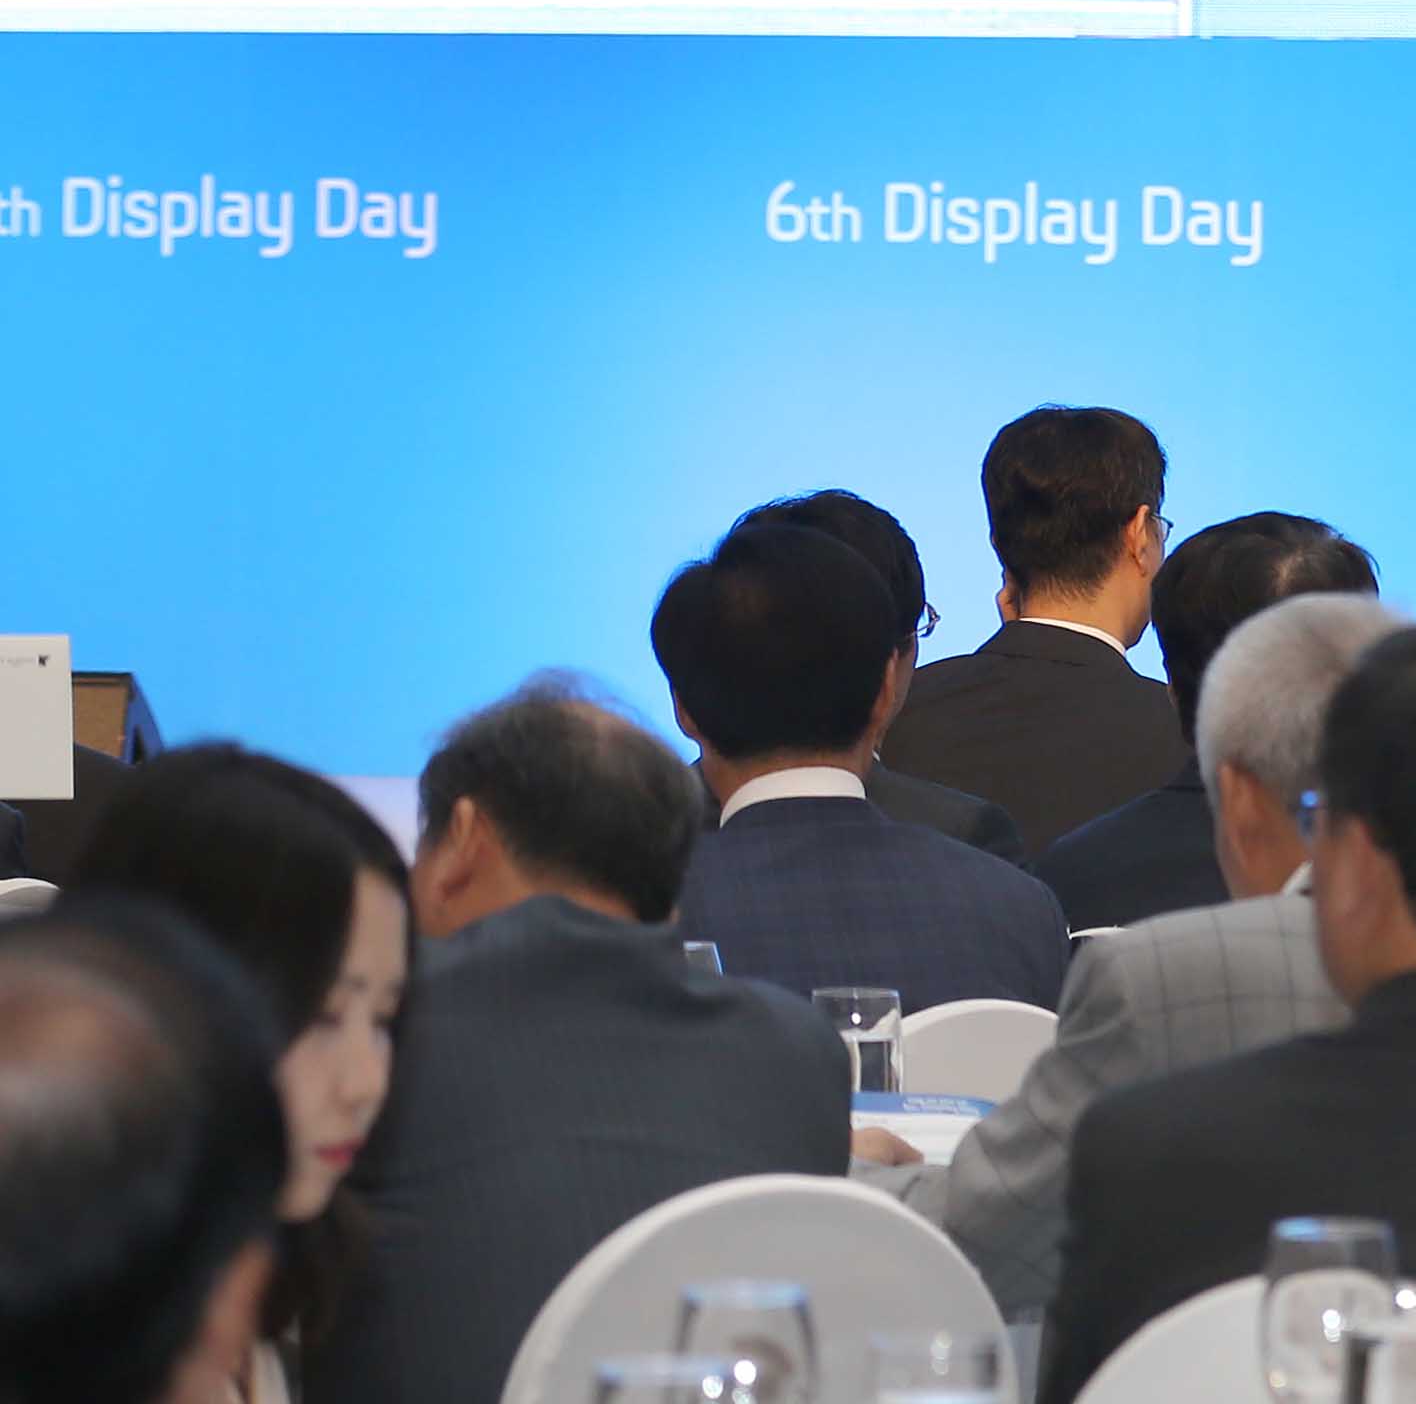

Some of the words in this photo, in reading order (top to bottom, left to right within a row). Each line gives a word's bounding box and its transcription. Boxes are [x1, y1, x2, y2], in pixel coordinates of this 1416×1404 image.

[62, 173, 294, 258] Display
[315, 177, 438, 258] Day
[766, 182, 862, 243] 6th
[884, 181, 1118, 265] Display
[1142, 185, 1263, 267] Day
